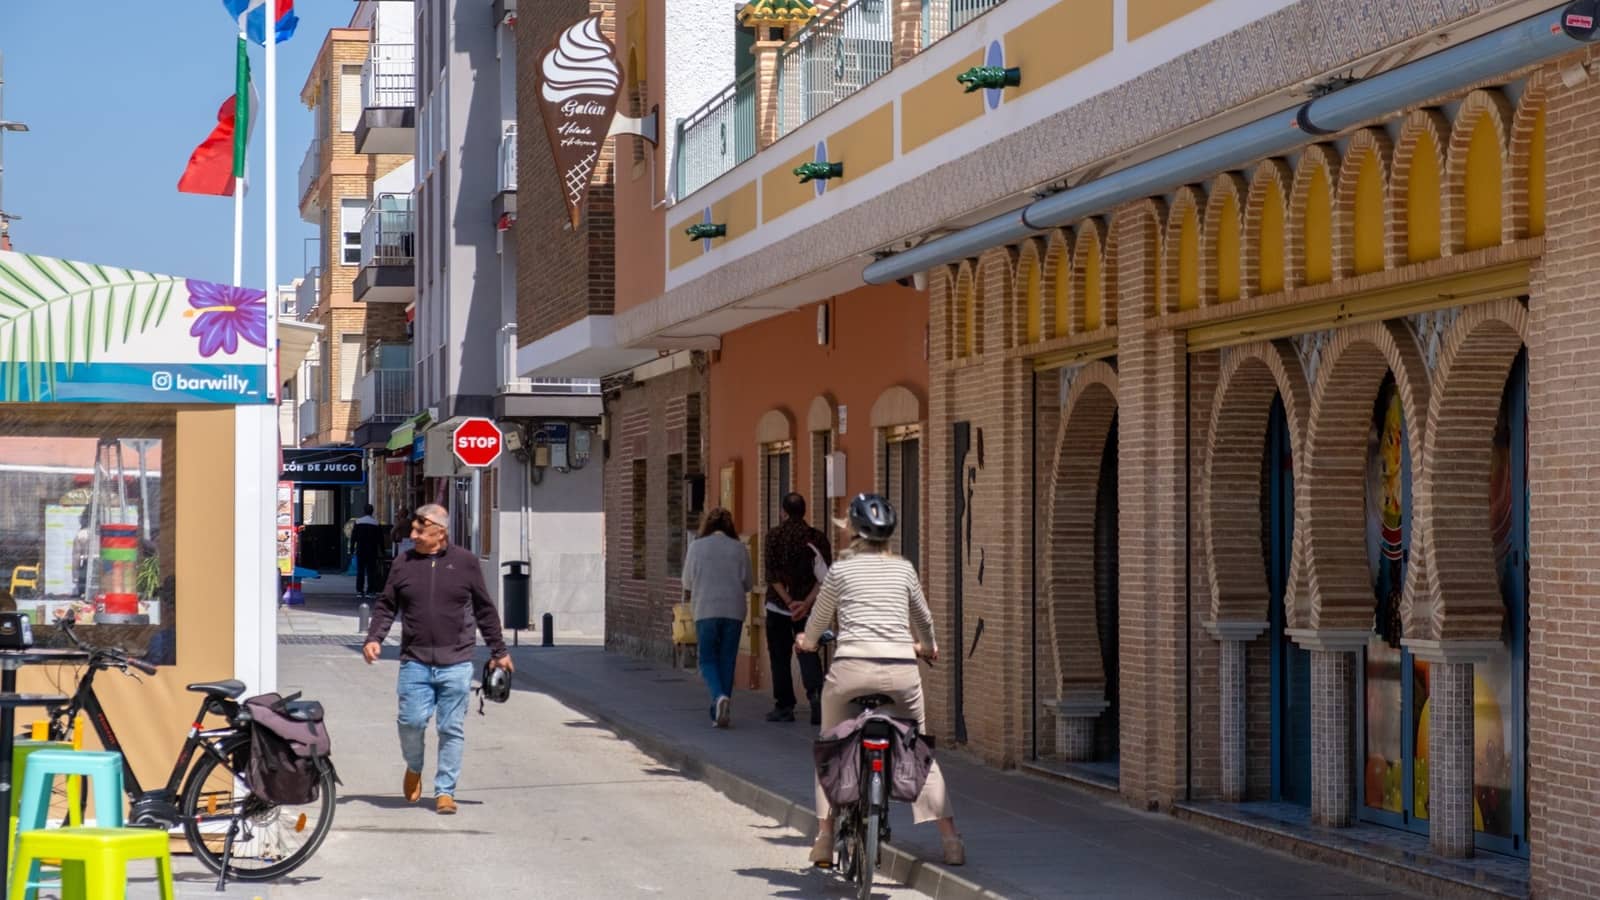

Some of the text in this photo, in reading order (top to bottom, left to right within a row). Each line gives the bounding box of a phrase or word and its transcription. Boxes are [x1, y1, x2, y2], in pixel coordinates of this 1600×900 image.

[176, 373, 258, 395] barwilly_
[458, 436, 498, 449] STOP
[307, 463, 321, 472] DE
[323, 463, 357, 472] JUEGO
